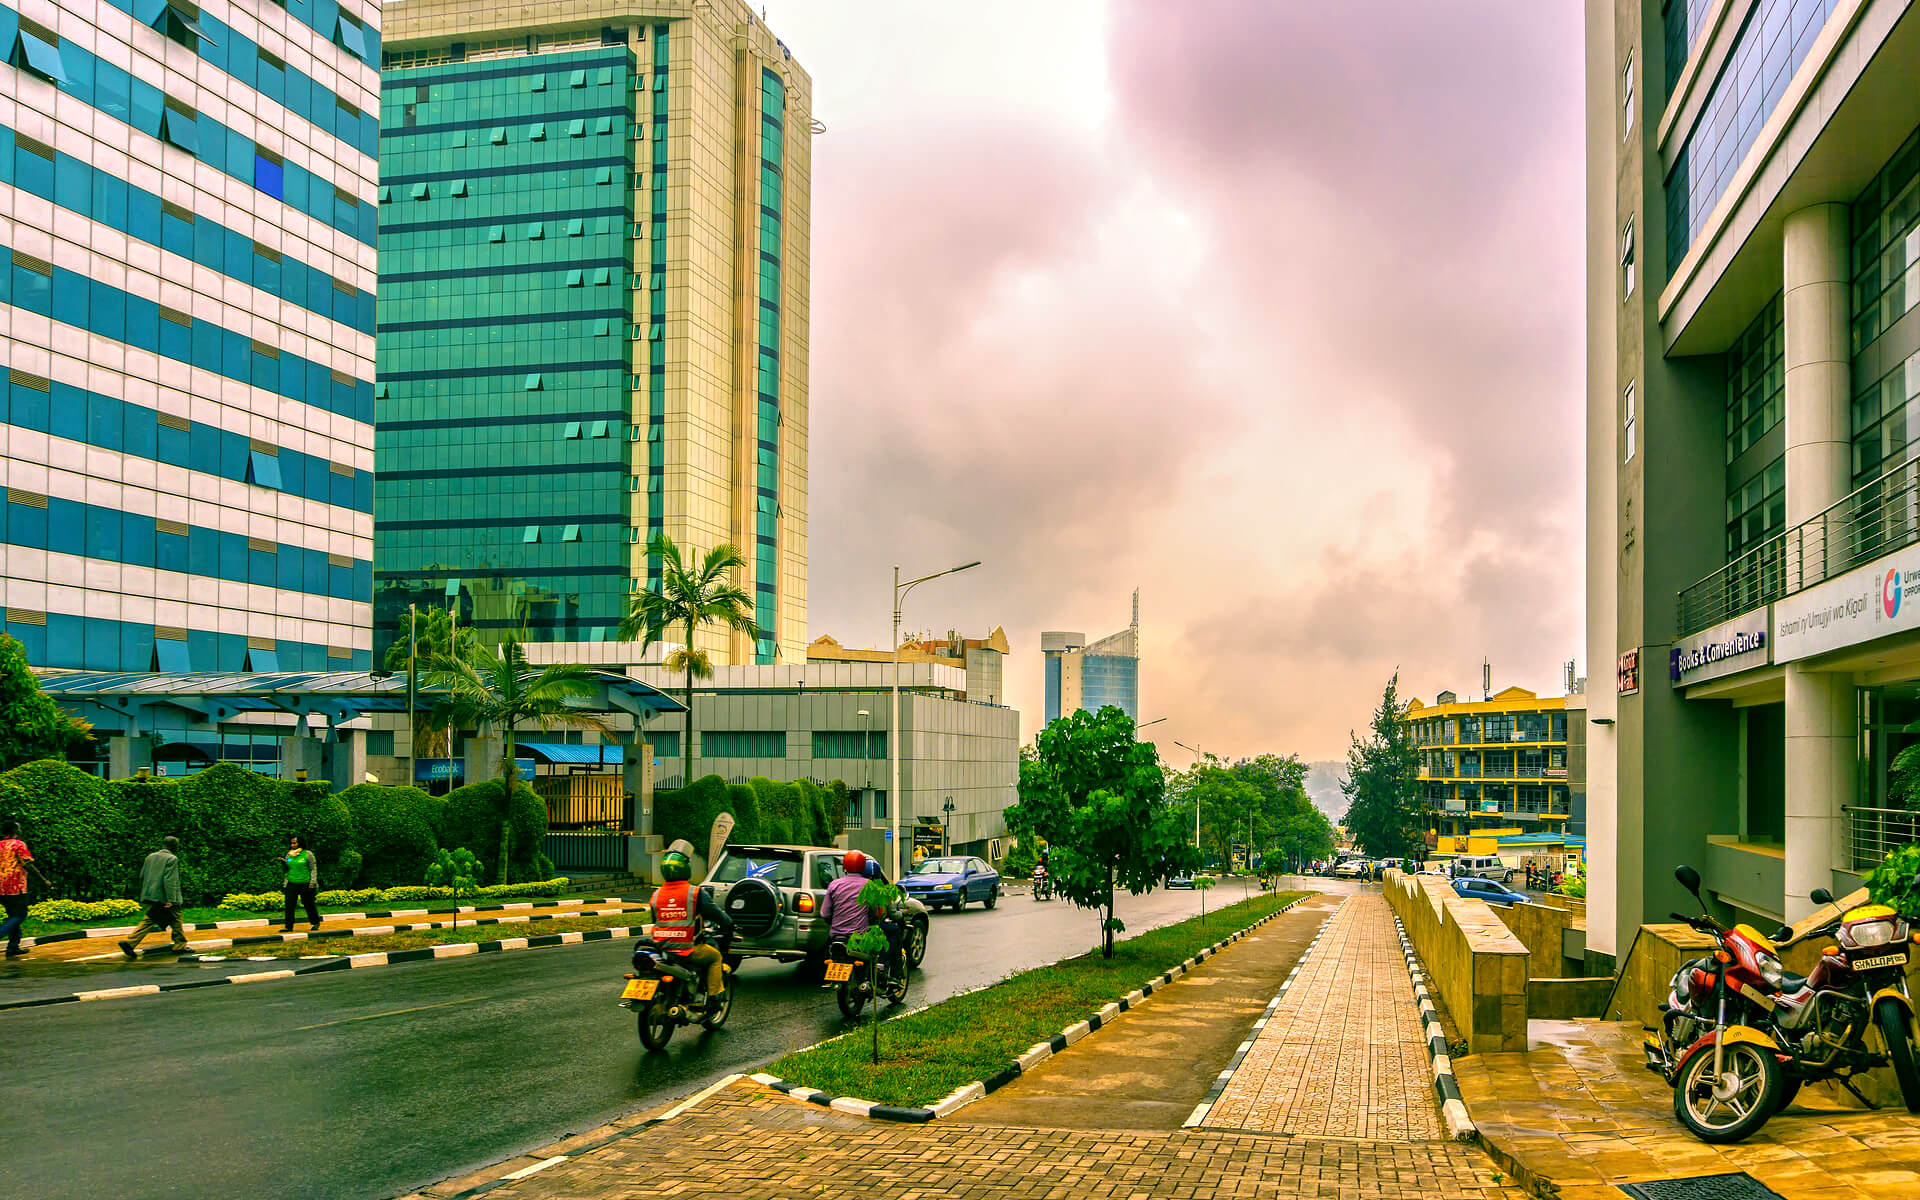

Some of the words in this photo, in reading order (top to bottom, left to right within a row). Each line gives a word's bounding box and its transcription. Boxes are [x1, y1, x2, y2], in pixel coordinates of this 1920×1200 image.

[1780, 617, 1800, 637] Ishami
[1833, 604, 1844, 618] wa
[1845, 592, 1868, 619] Kigali
[1678, 651, 1699, 673] Books
[1699, 645, 1706, 665] &
[1706, 632, 1760, 662] Convenience
